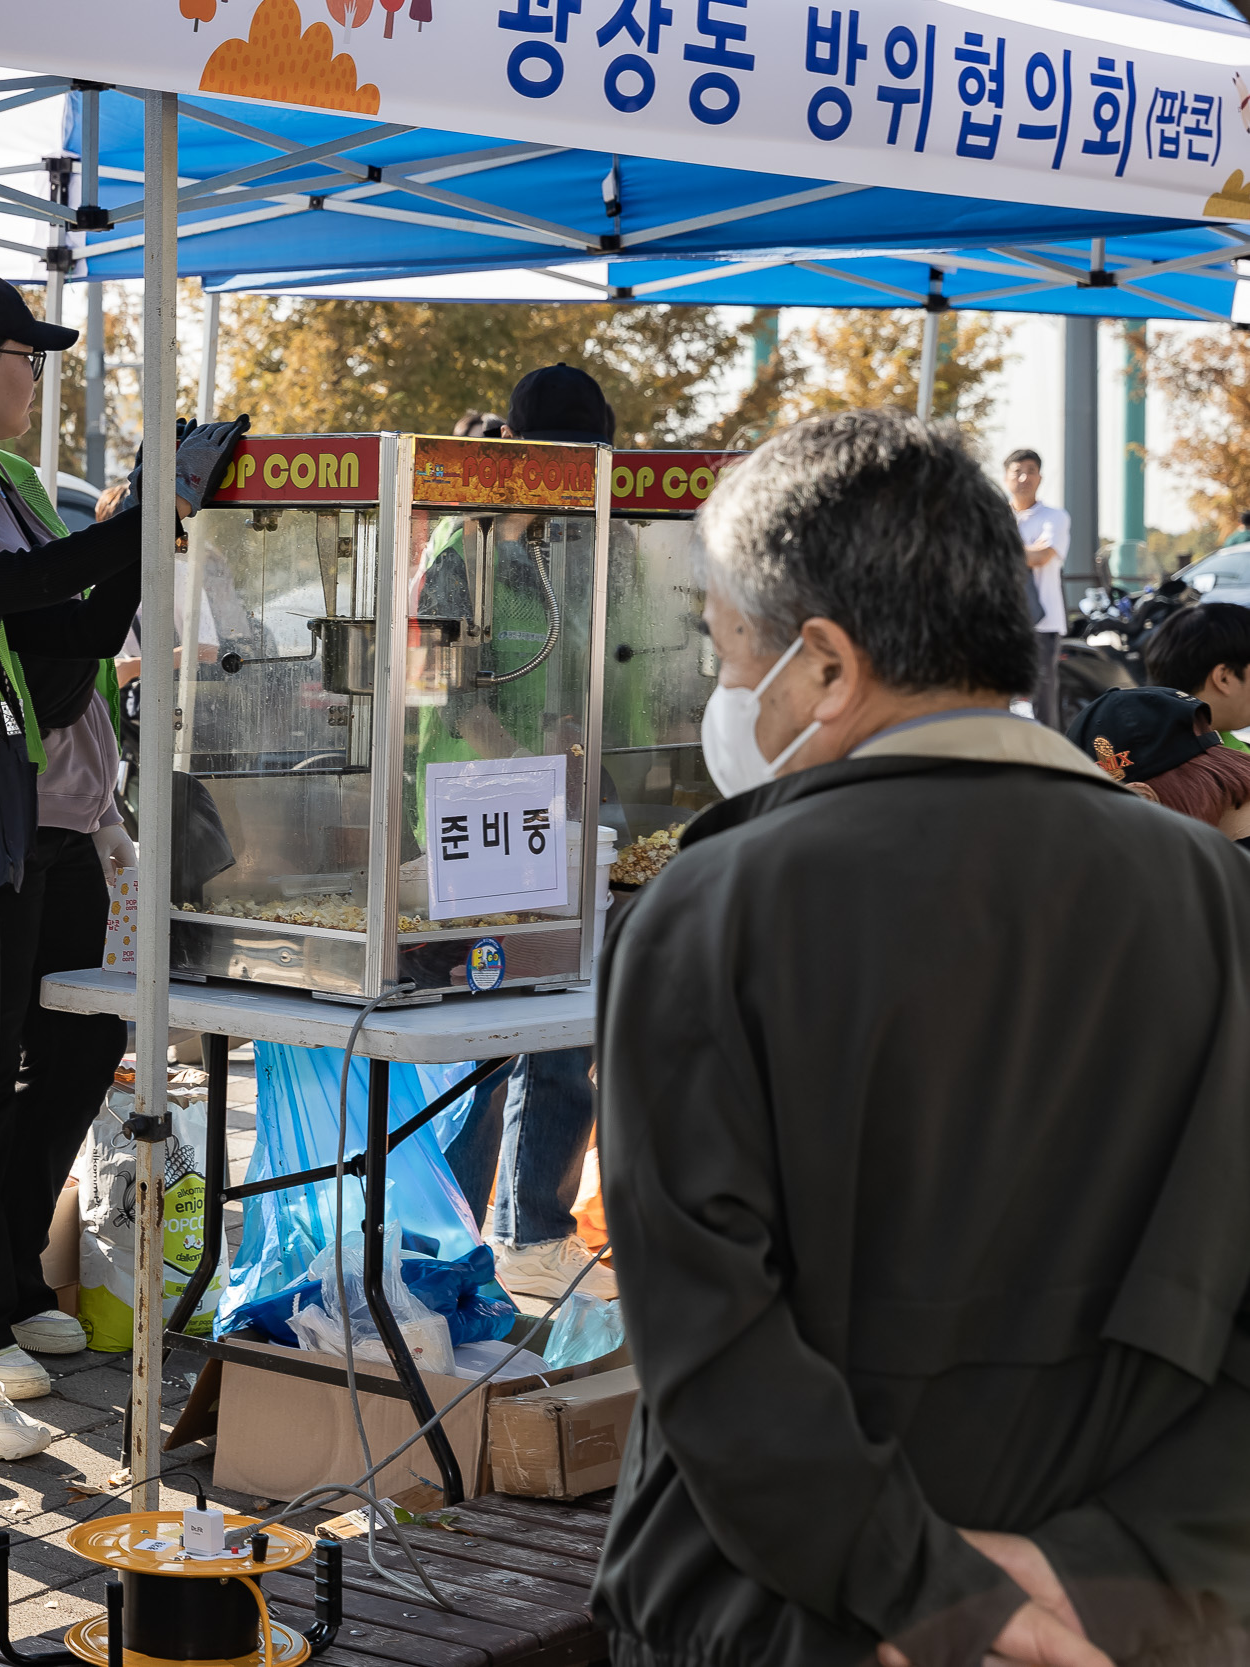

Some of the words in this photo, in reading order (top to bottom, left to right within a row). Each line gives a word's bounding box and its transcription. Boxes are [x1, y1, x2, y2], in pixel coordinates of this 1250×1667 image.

[262, 452, 360, 490] CORN
[462, 456, 514, 488] POP
[522, 458, 593, 492] CORN
